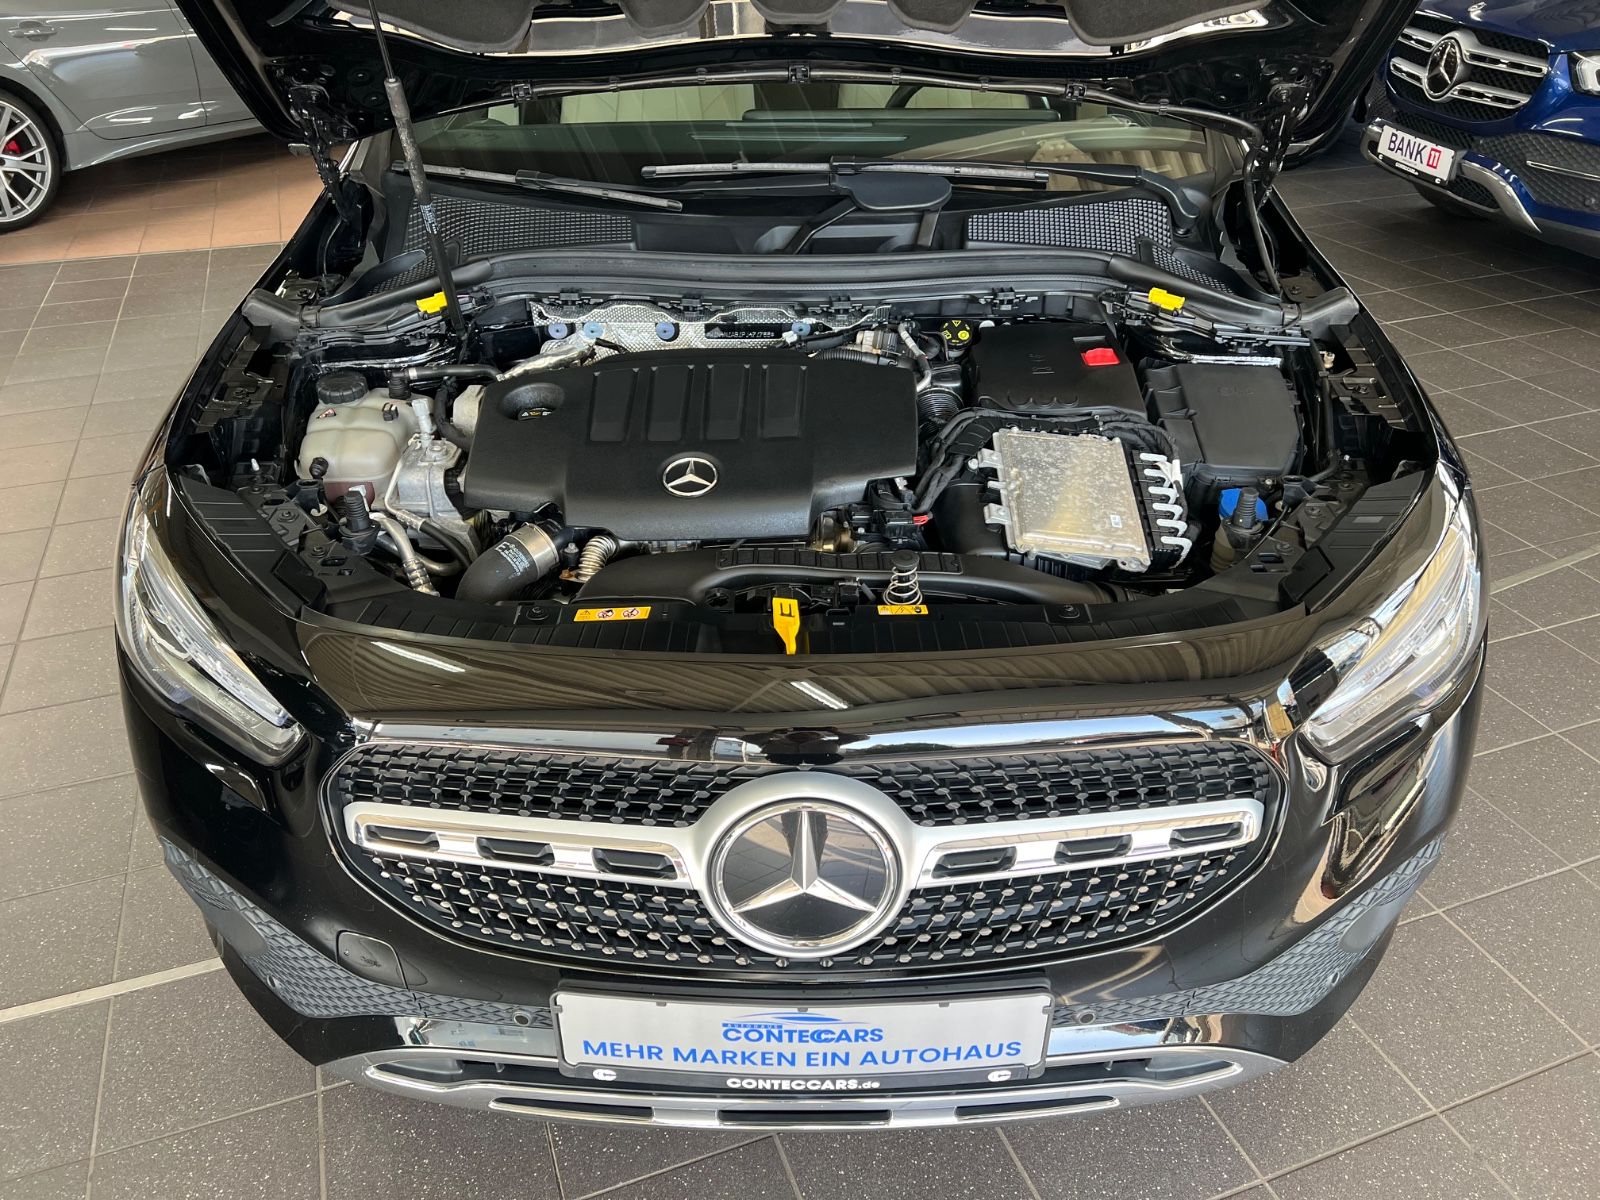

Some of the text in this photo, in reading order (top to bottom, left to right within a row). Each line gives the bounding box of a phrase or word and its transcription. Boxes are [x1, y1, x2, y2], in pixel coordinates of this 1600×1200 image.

[1388, 133, 1441, 168] BANK 11
[722, 1028, 884, 1043] CONTECCARS
[583, 1040, 1022, 1067] MEHR MARKEN EIN AUTOHAUS
[726, 1077, 881, 1091] CONTECCARS.de
